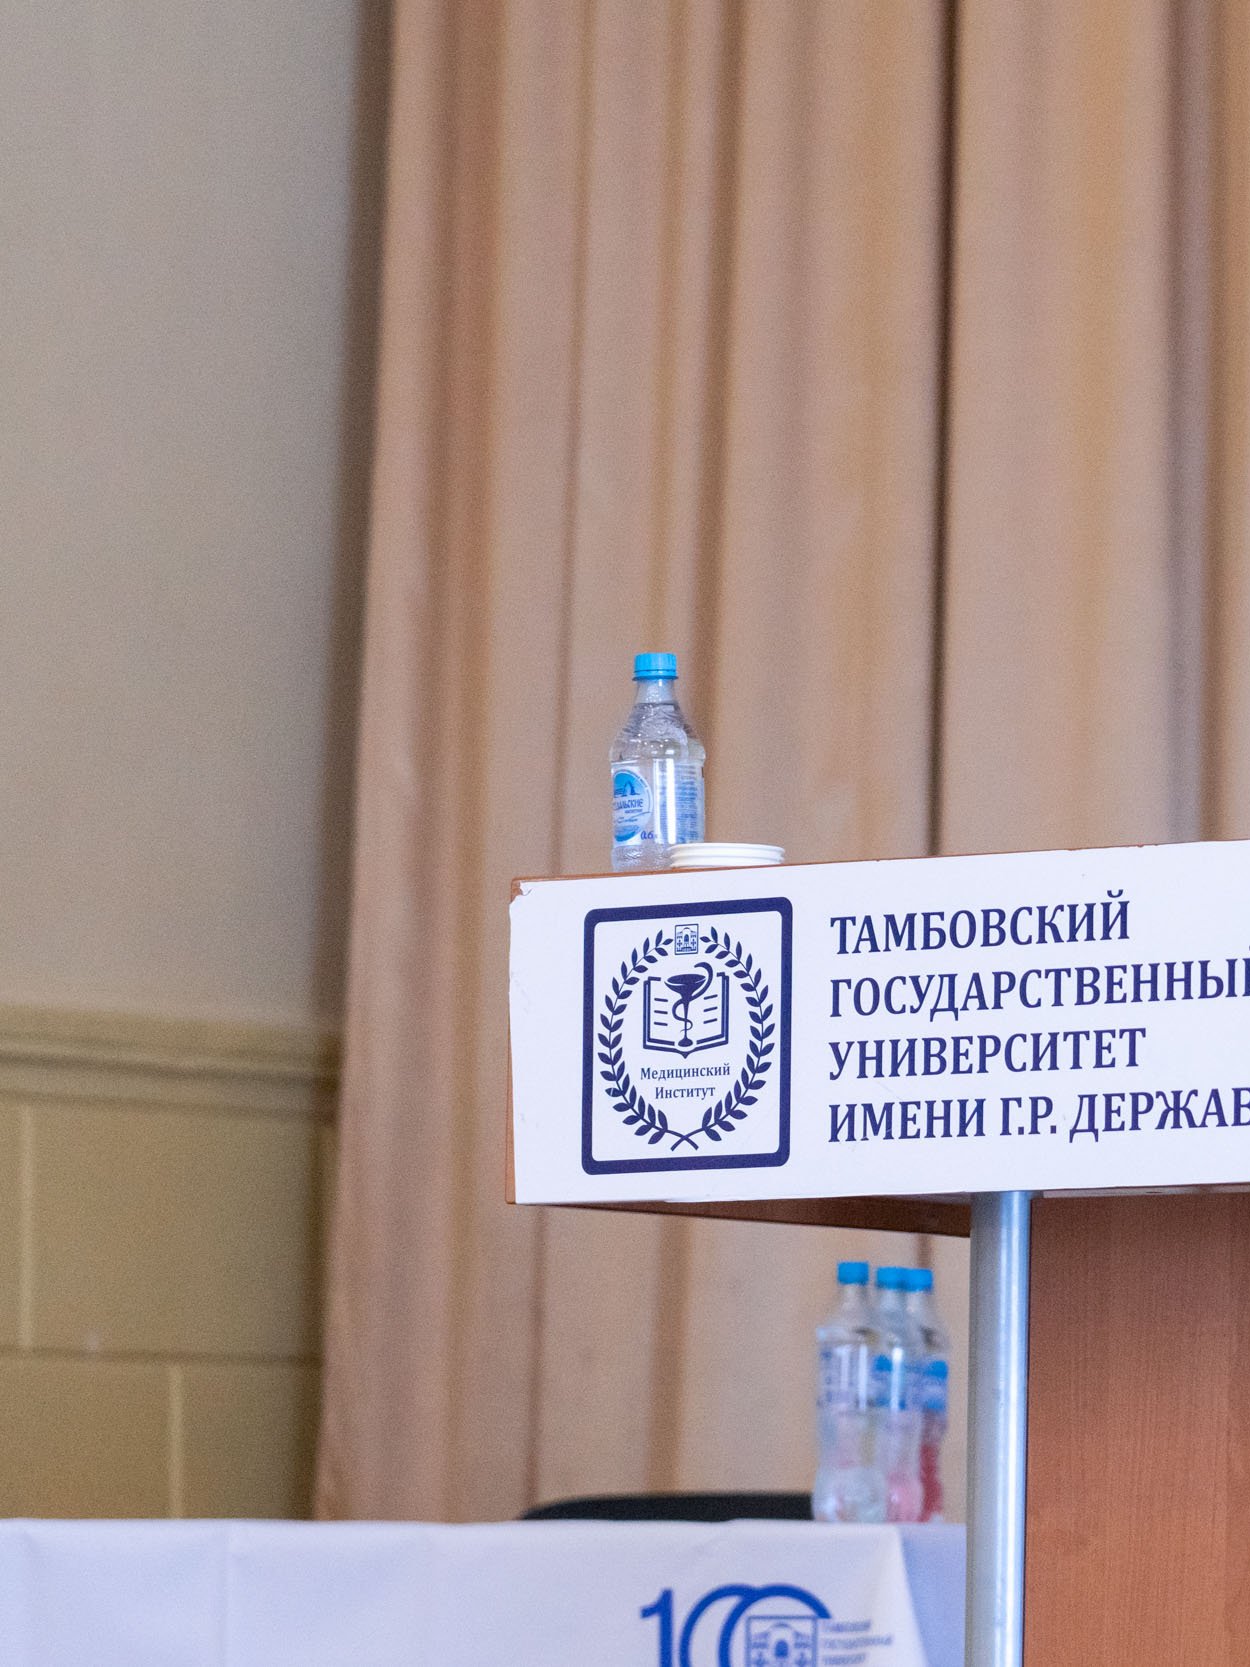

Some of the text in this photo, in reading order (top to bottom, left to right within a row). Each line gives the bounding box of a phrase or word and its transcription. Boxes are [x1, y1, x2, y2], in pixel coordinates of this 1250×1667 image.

[830, 889, 1130, 955] ТАМБОВСКИЙ
[640, 1062, 731, 1082] Медицинский
[828, 1027, 1147, 1081] УНИВЕРСИТЕТ
[655, 1086, 716, 1101] Институт
[828, 1098, 987, 1143] ИМЕНИ
[999, 1096, 1058, 1136] Г.Р.
